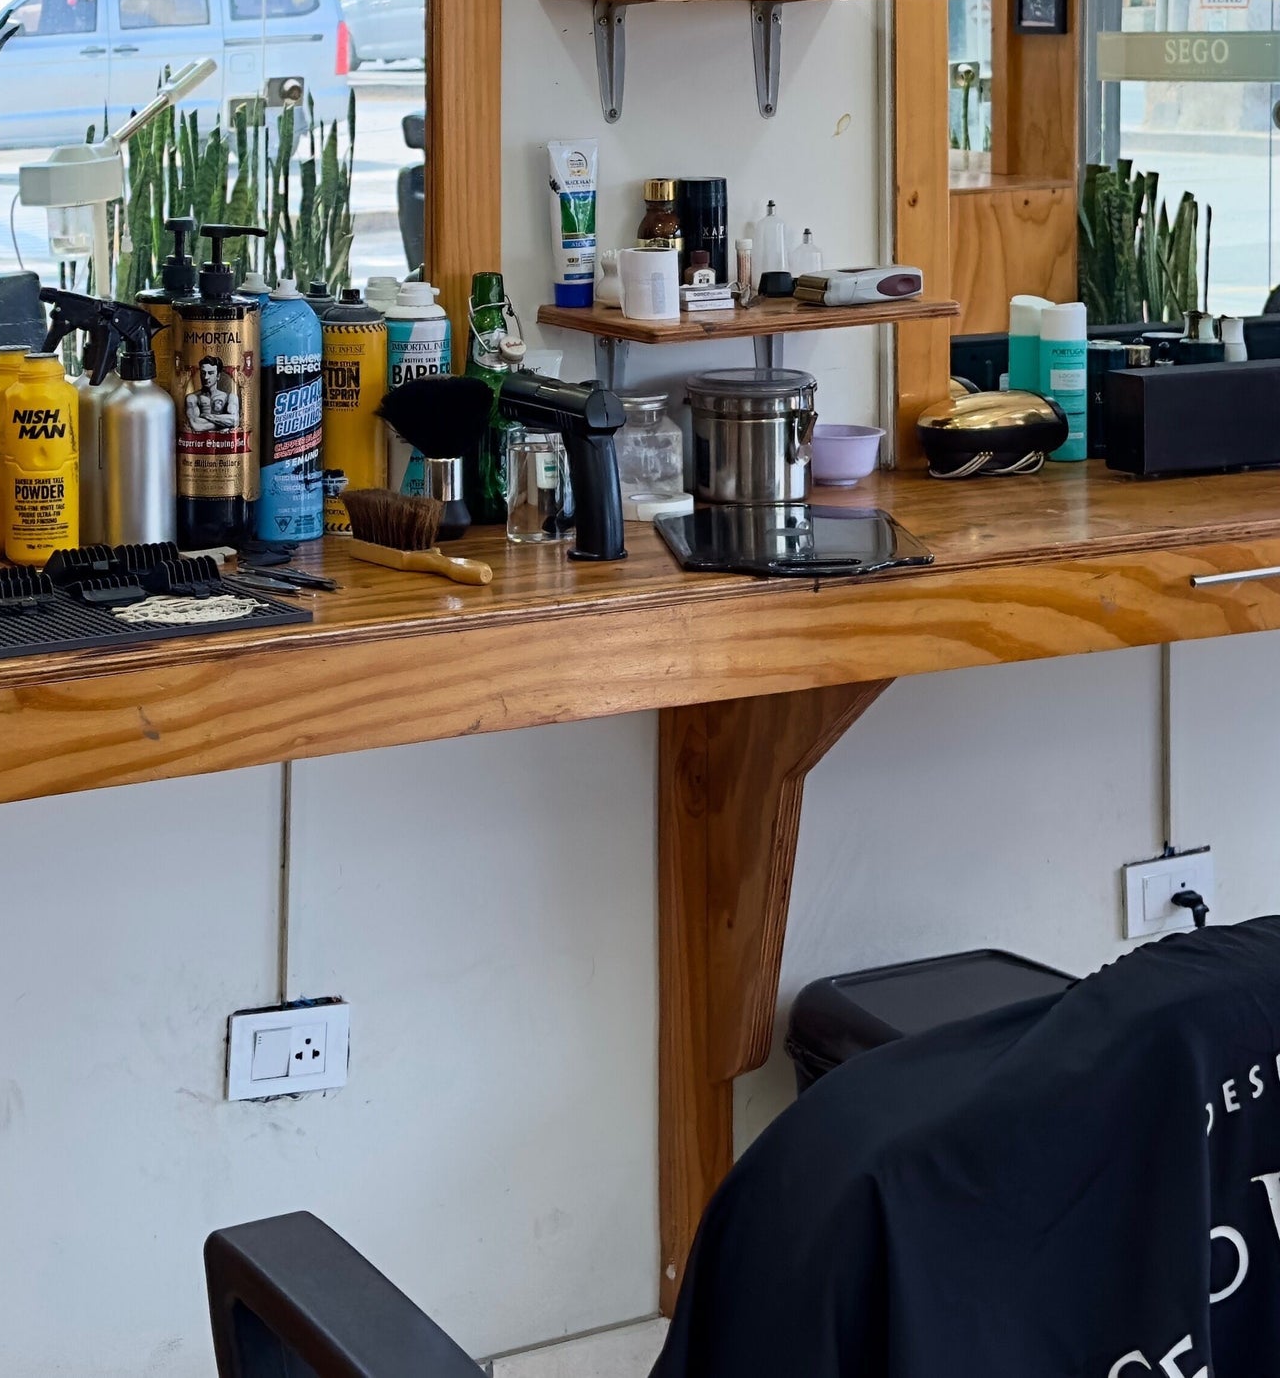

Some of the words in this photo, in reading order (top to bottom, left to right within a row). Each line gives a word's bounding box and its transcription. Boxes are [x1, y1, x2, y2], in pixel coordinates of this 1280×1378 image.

[1164, 38, 1229, 64] SEGO
[184, 331, 242, 345] IMMORTAL
[391, 342, 433, 352] IMMORTAL
[329, 389, 361, 401] SPRAY
[13, 408, 60, 424] NISH
[18, 423, 66, 439] MAN
[178, 437, 205, 449] Superior
[205, 437, 234, 449] Shaving
[285, 459, 291, 469] 5
[15, 484, 65, 500] POWDER
